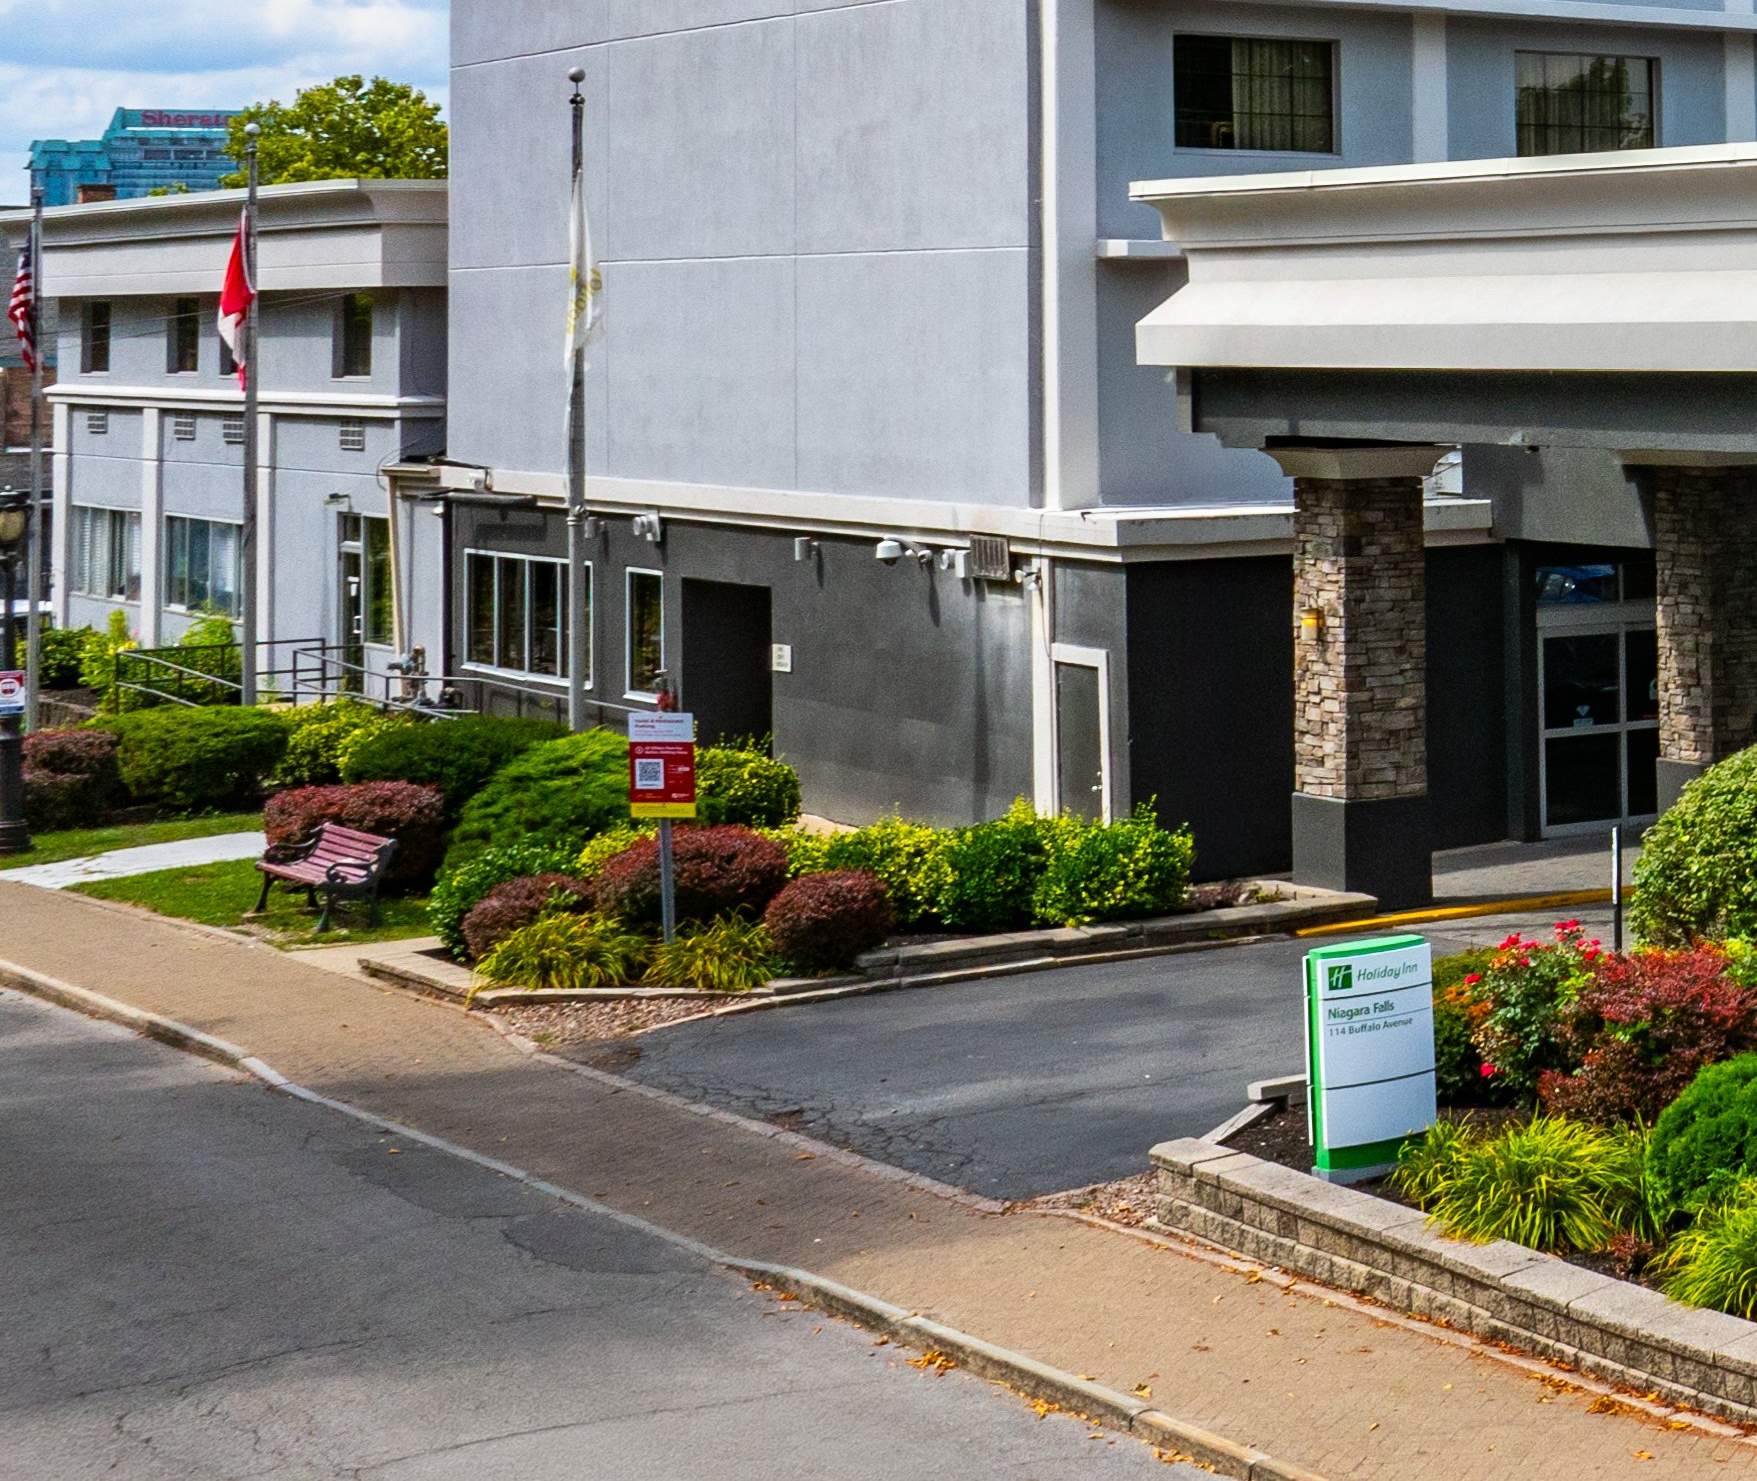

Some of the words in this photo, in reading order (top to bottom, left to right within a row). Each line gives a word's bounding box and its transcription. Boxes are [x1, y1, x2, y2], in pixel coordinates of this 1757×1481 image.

[141, 109, 230, 127] Sherat
[1328, 1007, 1370, 1020] Niagara
[1373, 1000, 1395, 1014] Falls
[1329, 1027, 1346, 1037] 114
[1348, 1022, 1381, 1035] Buffalo
[1382, 1017, 1414, 1030] Avenue
